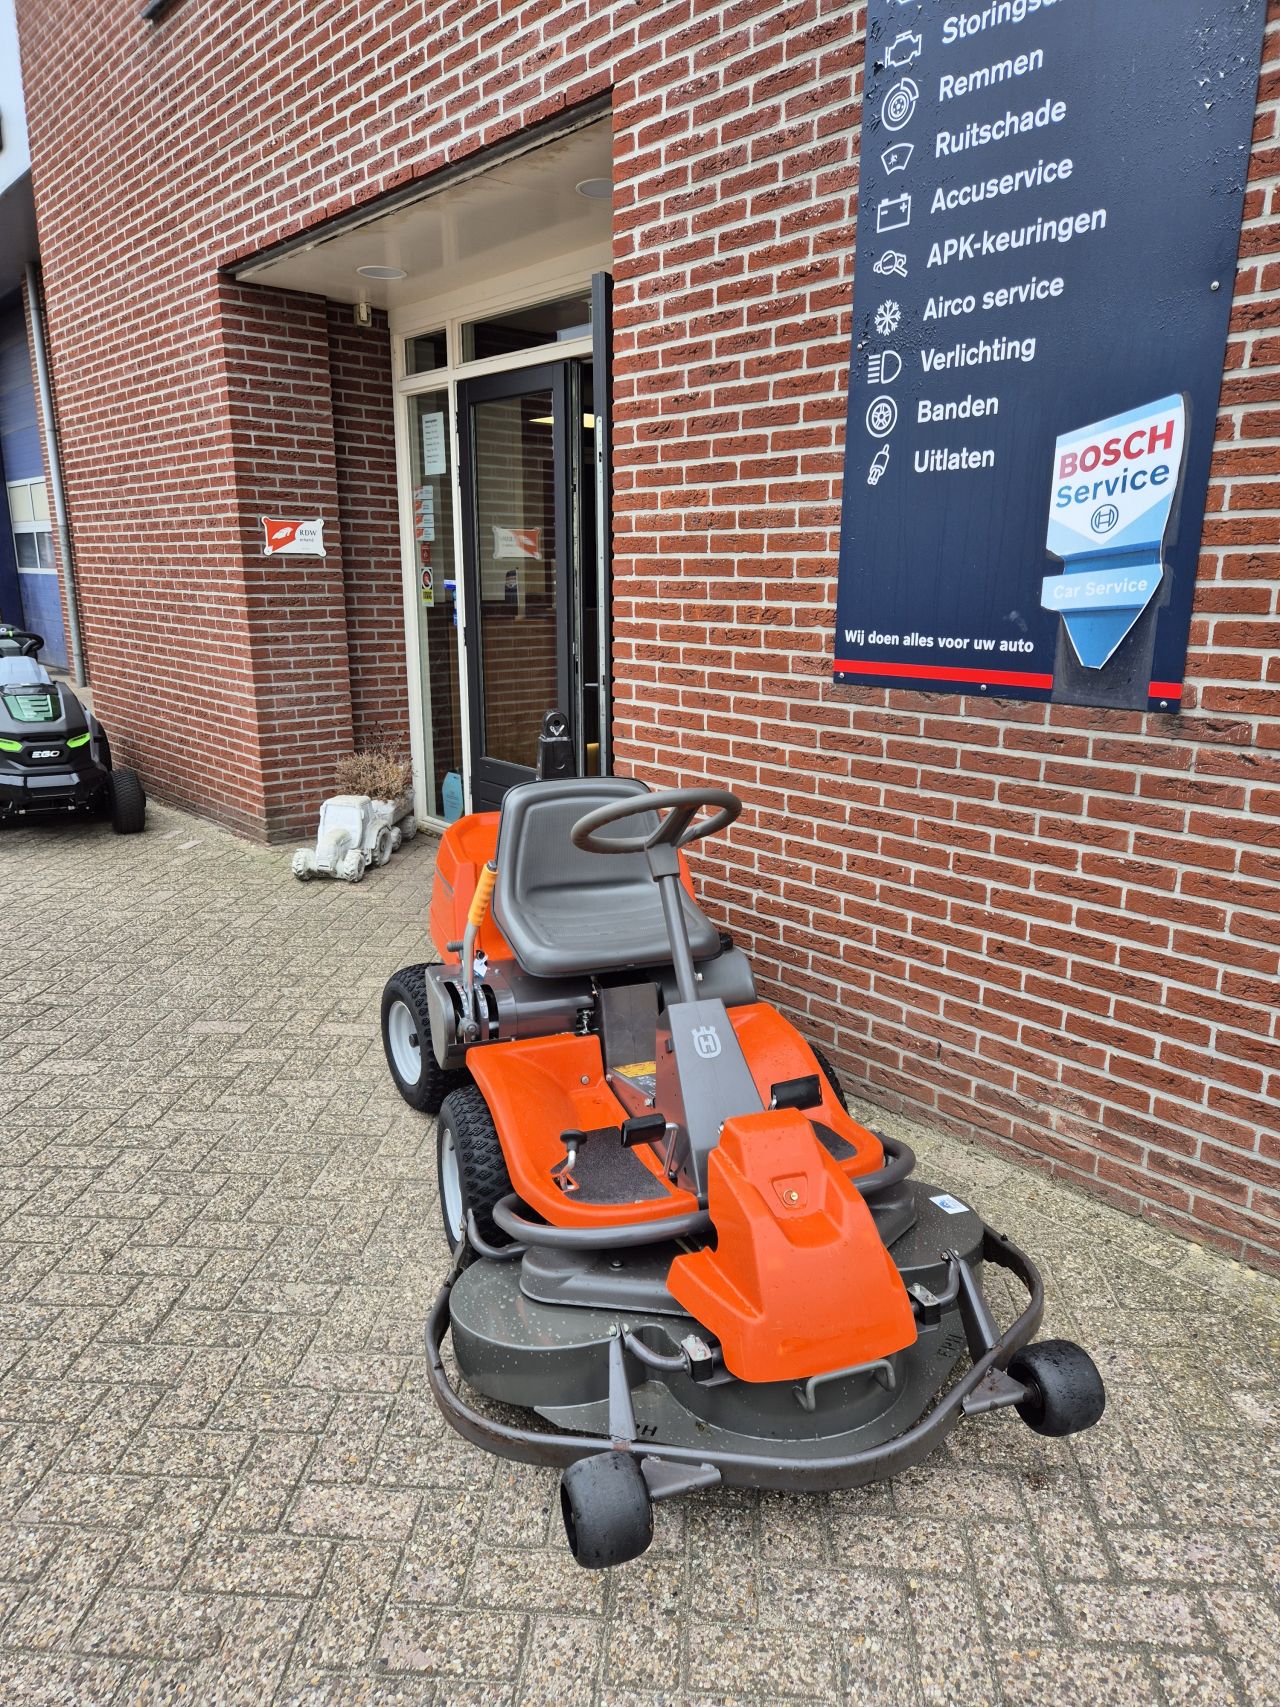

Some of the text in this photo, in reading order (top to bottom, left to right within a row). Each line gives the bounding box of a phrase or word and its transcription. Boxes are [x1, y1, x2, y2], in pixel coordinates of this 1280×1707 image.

[939, 48, 1044, 101] Remmen
[935, 98, 1067, 158] Ruitschade
[930, 158, 1073, 214] Accuservice
[926, 208, 1107, 268] APK-keuringen
[923, 277, 1065, 321] Airco service
[921, 336, 1037, 372] Verlichting
[917, 395, 999, 424] Banden
[914, 447, 995, 473] Uitlaten
[1059, 420, 1174, 480] BOSCH
[1056, 464, 1169, 508] Service
[1053, 579, 1148, 599] Car Service
[845, 630, 1034, 653] Wij doen alles voor uw auto
[32, 750, 60, 758] EGO
